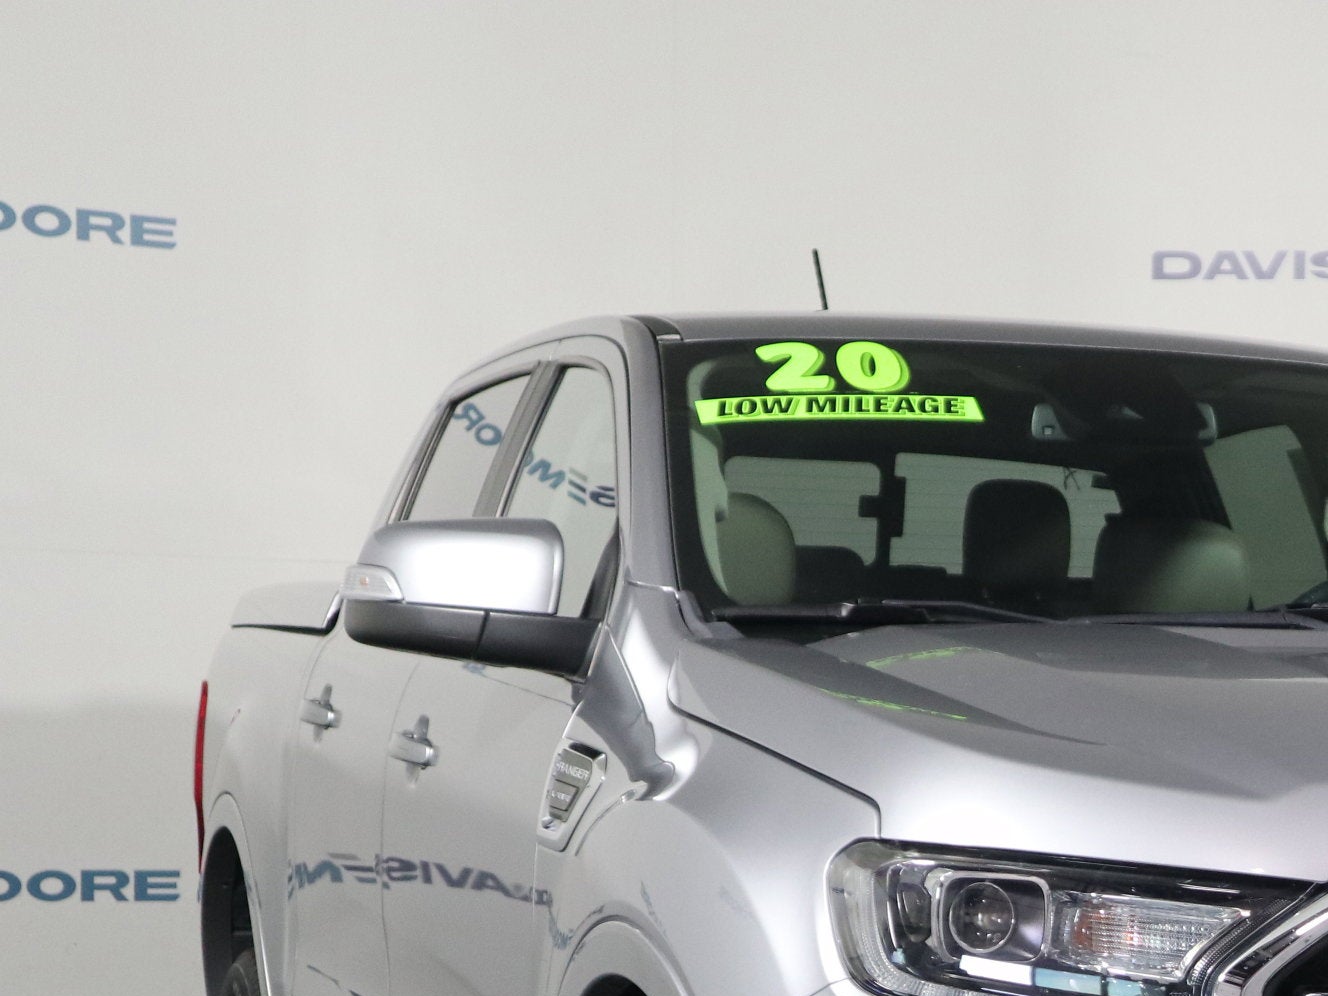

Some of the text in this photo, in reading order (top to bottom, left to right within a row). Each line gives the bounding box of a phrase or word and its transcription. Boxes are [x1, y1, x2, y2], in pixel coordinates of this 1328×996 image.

[755, 341, 911, 393] 20
[716, 395, 966, 417] LOW MILEAGE
